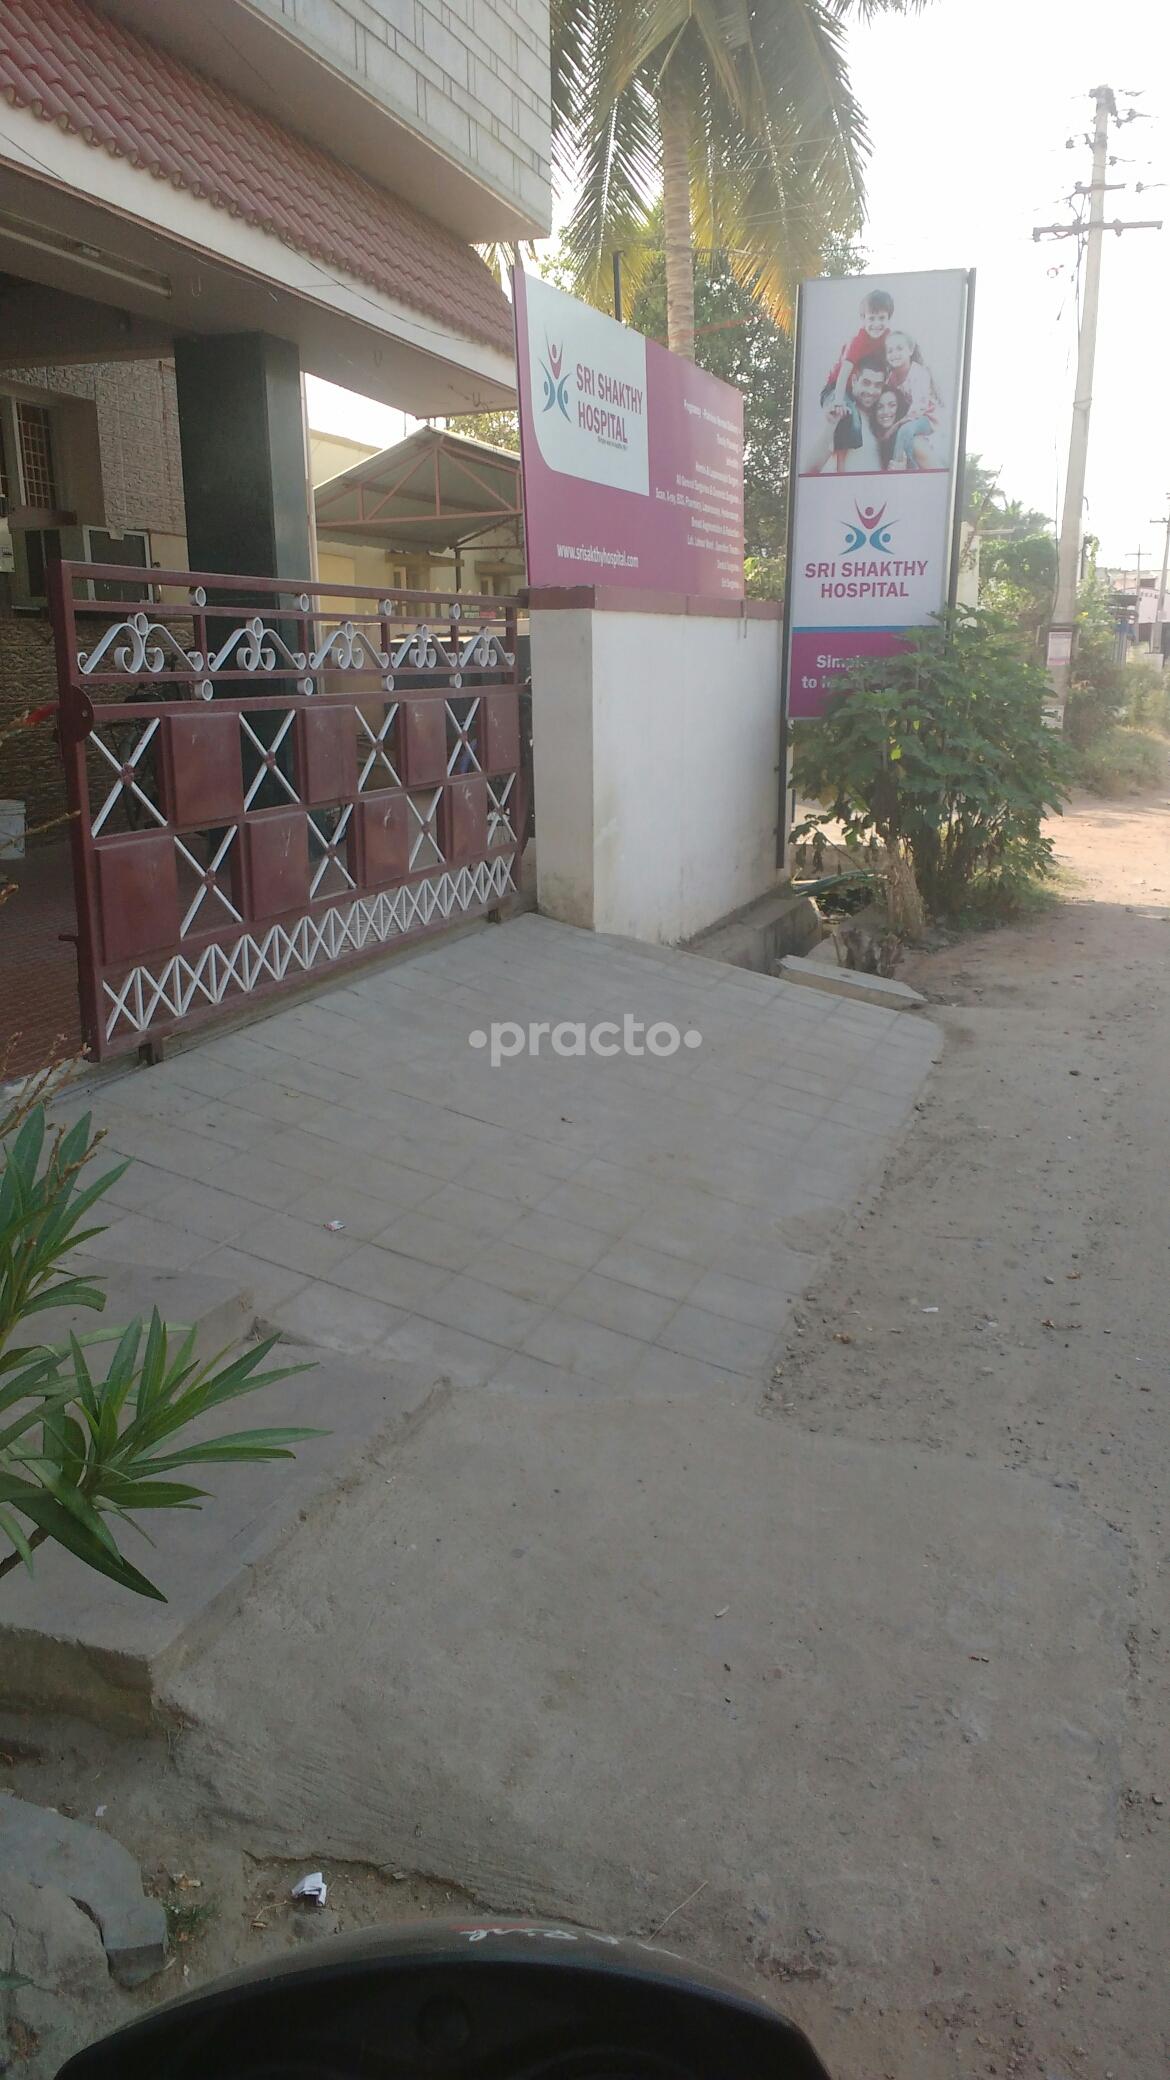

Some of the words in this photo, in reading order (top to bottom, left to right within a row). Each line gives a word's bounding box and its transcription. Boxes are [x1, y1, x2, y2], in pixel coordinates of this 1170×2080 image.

[576, 362, 595, 397] SRI
[598, 372, 643, 416] SHAKTHY
[578, 400, 628, 444] HOSPITAL
[805, 562, 836, 578] SRI
[841, 560, 928, 577] SHAKTHY
[821, 582, 909, 598] HOSPITAL
[801, 676, 817, 689] to
